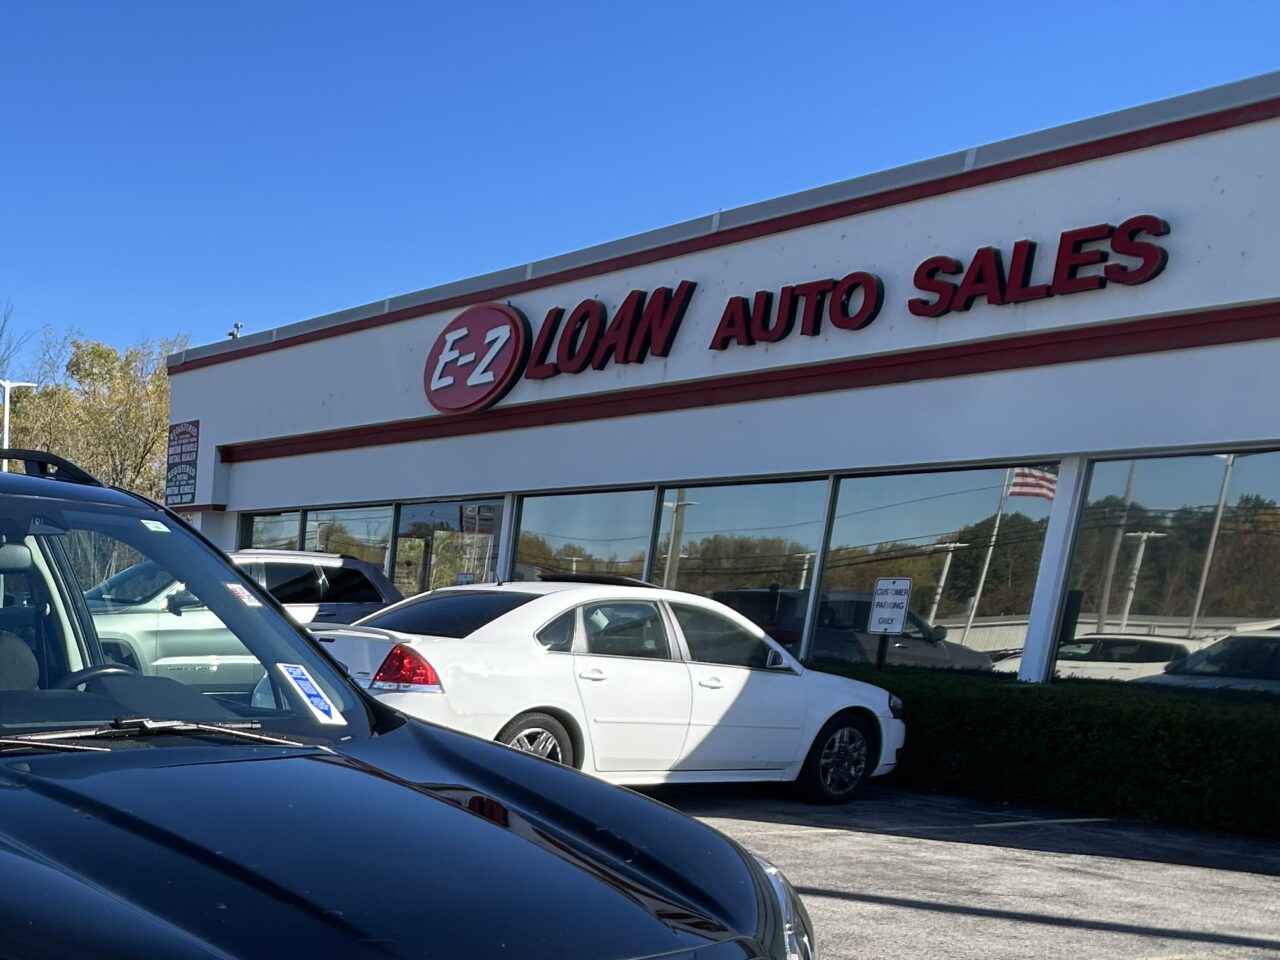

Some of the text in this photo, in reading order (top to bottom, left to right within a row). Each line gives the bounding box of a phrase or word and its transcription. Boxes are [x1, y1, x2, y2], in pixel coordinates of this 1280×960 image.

[431, 214, 1170, 391] E-Z LOAN AUTO SALES
[168, 465, 195, 480] REGISTERED
[878, 617, 896, 625] ONLY
